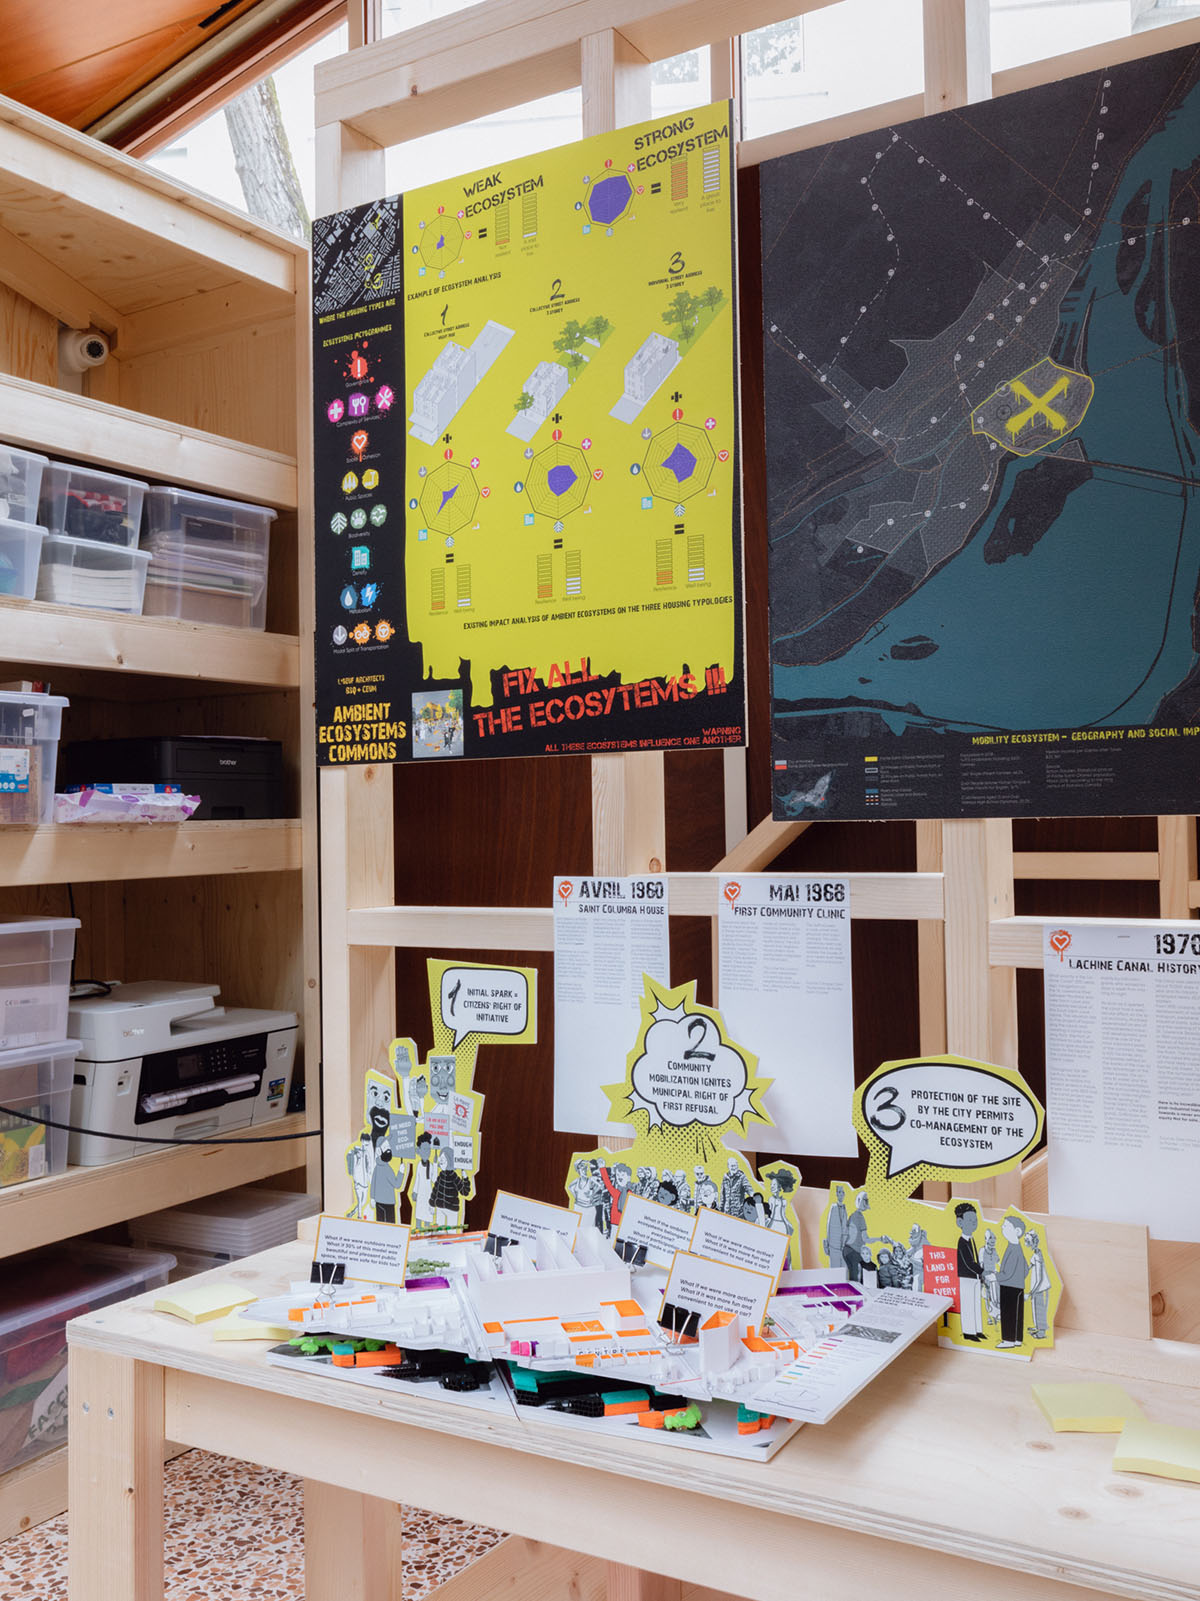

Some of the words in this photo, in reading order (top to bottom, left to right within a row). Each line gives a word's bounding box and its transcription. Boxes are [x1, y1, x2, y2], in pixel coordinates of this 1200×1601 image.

[634, 117, 695, 151] STRONG
[636, 125, 728, 171] ECOSYSTEM
[463, 172, 502, 198] WEAK
[465, 175, 544, 218] ECOSYSTEM
[668, 251, 686, 274] 3
[407, 289, 432, 301] EXAMPLE
[442, 277, 472, 292] ECOSYSTEM
[473, 272, 502, 285] ANALYSIS
[550, 278, 565, 301] 2
[319, 314, 336, 324] WHERE
[336, 311, 346, 319] THE
[346, 305, 368, 317] HOUSING
[368, 301, 384, 311] TYPES
[386, 298, 396, 307] ARE
[441, 304, 448, 326] 1
[464, 621, 488, 630] EXISTING
[489, 619, 510, 627] IMPACT
[512, 615, 540, 625] ANALYSIS
[551, 612, 576, 620] AMBIENT
[577, 607, 616, 618] ECOSYSTEMS
[618, 606, 626, 614] ON
[628, 605, 640, 613] THE
[642, 603, 661, 611] THREE
[663, 599, 690, 609] HOUSING
[693, 596, 733, 607] TYPOLOGIES
[356, 674, 384, 684] ARCHITECTS
[502, 667, 539, 698] FIX
[547, 657, 599, 689] ALL
[472, 706, 523, 738] THE
[529, 673, 697, 728] ECOSYTEMS
[704, 667, 727, 696] !!!
[333, 702, 391, 723] AMBIENT
[319, 721, 407, 743] ECOSYSTEMS
[972, 735, 1009, 745] MOBILITY
[1011, 733, 1060, 744] ECOSYSTEM
[1071, 729, 1124, 741] GEOGRAPHY
[1128, 729, 1146, 739] AND
[1148, 727, 1181, 738] SOCIAL
[328, 741, 397, 762] COMMONS
[545, 744, 560, 752] ALL
[562, 742, 585, 751] THESE
[586, 740, 638, 750] ECOSYSTEMS
[639, 737, 682, 747] INFLUENCE
[683, 736, 700, 745] ONE
[702, 734, 742, 745] ANOTHER
[579, 880, 626, 899] AVRIL
[805, 883, 845, 902] 1968
[578, 904, 600, 913] SAINT
[602, 904, 638, 914] COLUMBA
[640, 905, 664, 915] HOUSE
[734, 906, 758, 917] FIRST
[760, 907, 814, 919] COMMUNITY
[816, 908, 846, 919] CLINIC
[1068, 958, 1113, 970] LACHINE
[1116, 960, 1154, 973] CANAL
[448, 979, 462, 1016] 1
[467, 988, 488, 997] INITIAL
[490, 989, 513, 998] SPARK
[493, 1002, 512, 1010] RIGHT
[476, 1014, 509, 1023] INITIATIVE
[683, 1018, 716, 1062] 2
[667, 1060, 712, 1073] COMMUNITY
[649, 1074, 700, 1086] MOBILIZATION
[701, 1077, 732, 1088] IGNITES
[652, 1087, 692, 1099] MUNICIPAL
[694, 1090, 716, 1101] RIGHT
[718, 1092, 729, 1102] OF
[911, 1090, 964, 1102] PROTECTION
[967, 1094, 978, 1103] OF
[982, 1095, 1000, 1105] THE
[1002, 1096, 1021, 1107] SITE
[663, 1101, 683, 1111] FIRST
[685, 1103, 718, 1114] REFUSAL
[870, 1086, 907, 1131] 3
[917, 1105, 930, 1115] BY
[933, 1106, 950, 1116] THE
[952, 1108, 972, 1118] CITY
[975, 1110, 1014, 1122] PERMITS
[910, 1119, 988, 1134] CO-MANAGEMENT
[991, 1126, 1002, 1136] OF
[1006, 1127, 1024, 1138] THE
[454, 1140, 472, 1148] ENOUGH
[940, 1136, 993, 1150] ECOSYSTEM
[454, 1156, 472, 1164] ENOUGH
[929, 1251, 946, 1260] THIS
[926, 1263, 946, 1272] LAND
[946, 1262, 954, 1271] IS
[935, 1275, 950, 1284] FOR
[680, 1286, 695, 1294] What
[680, 1278, 694, 1287] What
[736, 1295, 756, 1304] active?
[933, 1287, 956, 1296] EVERY
[678, 1294, 706, 1306] convenient
[739, 1310, 752, 1318] car?
